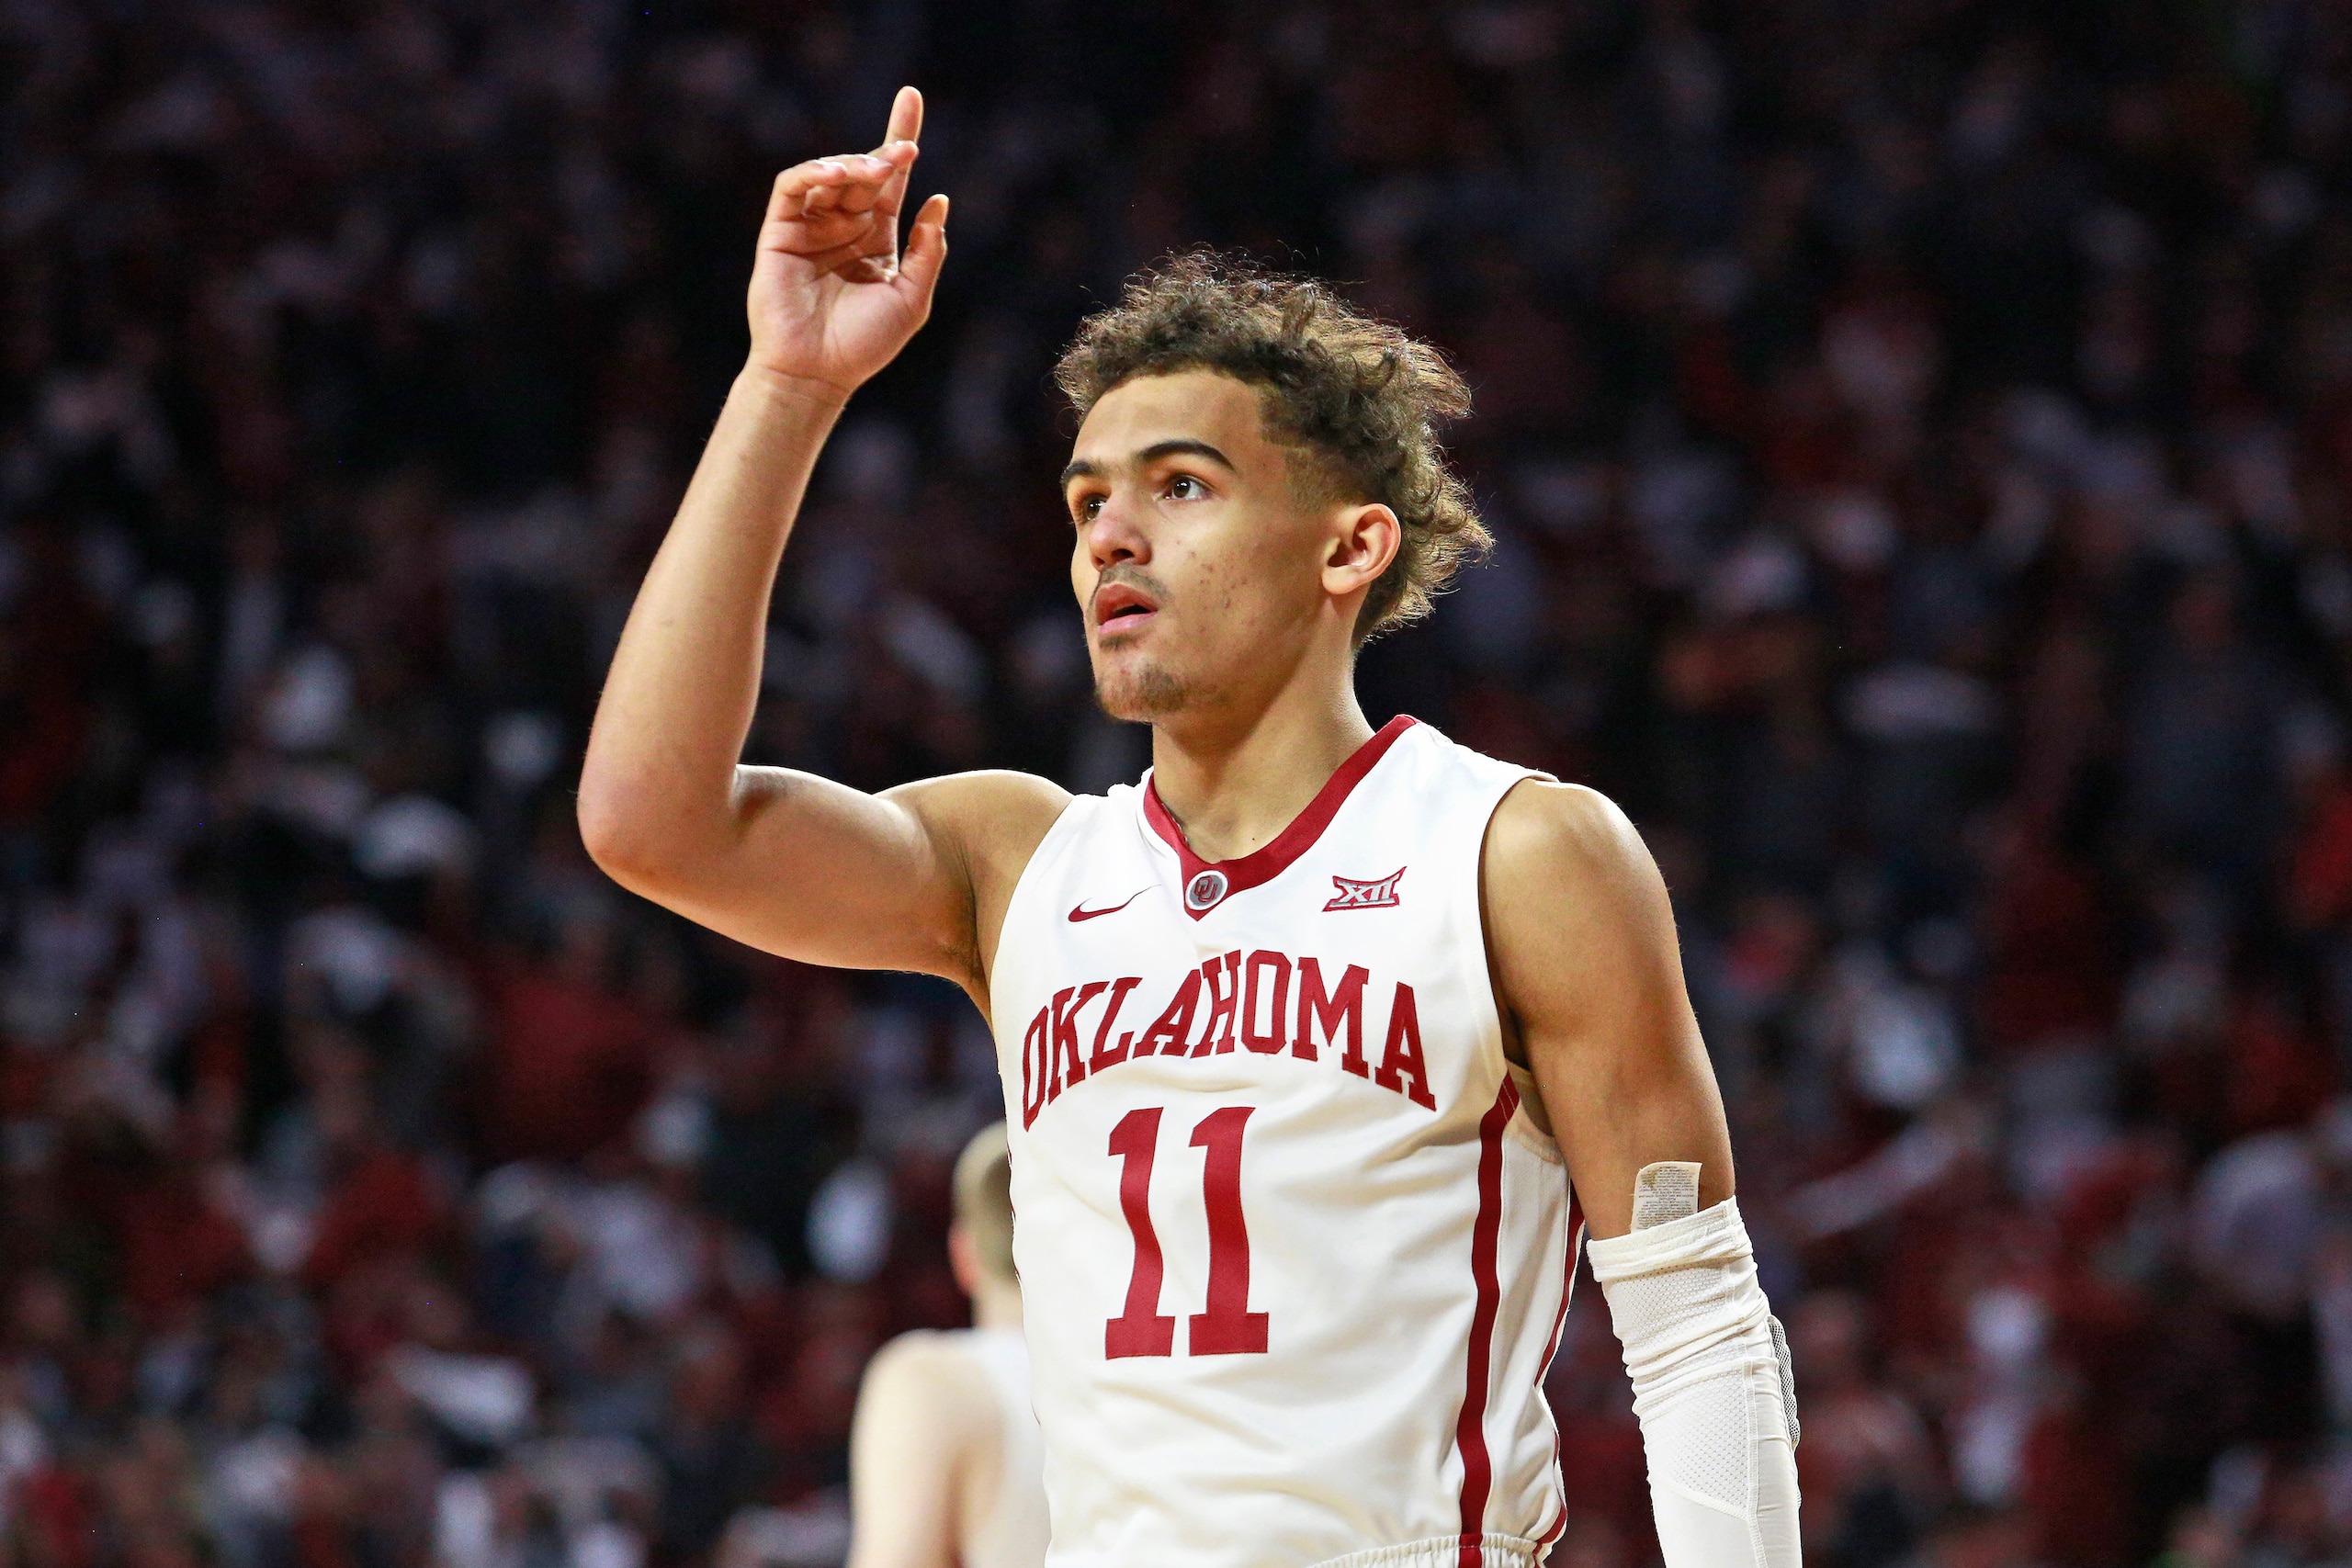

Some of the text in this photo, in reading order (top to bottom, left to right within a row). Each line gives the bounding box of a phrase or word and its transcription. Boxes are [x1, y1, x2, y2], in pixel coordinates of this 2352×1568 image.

[1193, 875, 1218, 903] OU
[1324, 868, 1405, 910] XII
[1023, 950, 1436, 1132] OKLAHOMA
[1105, 1106, 1269, 1359] 11
